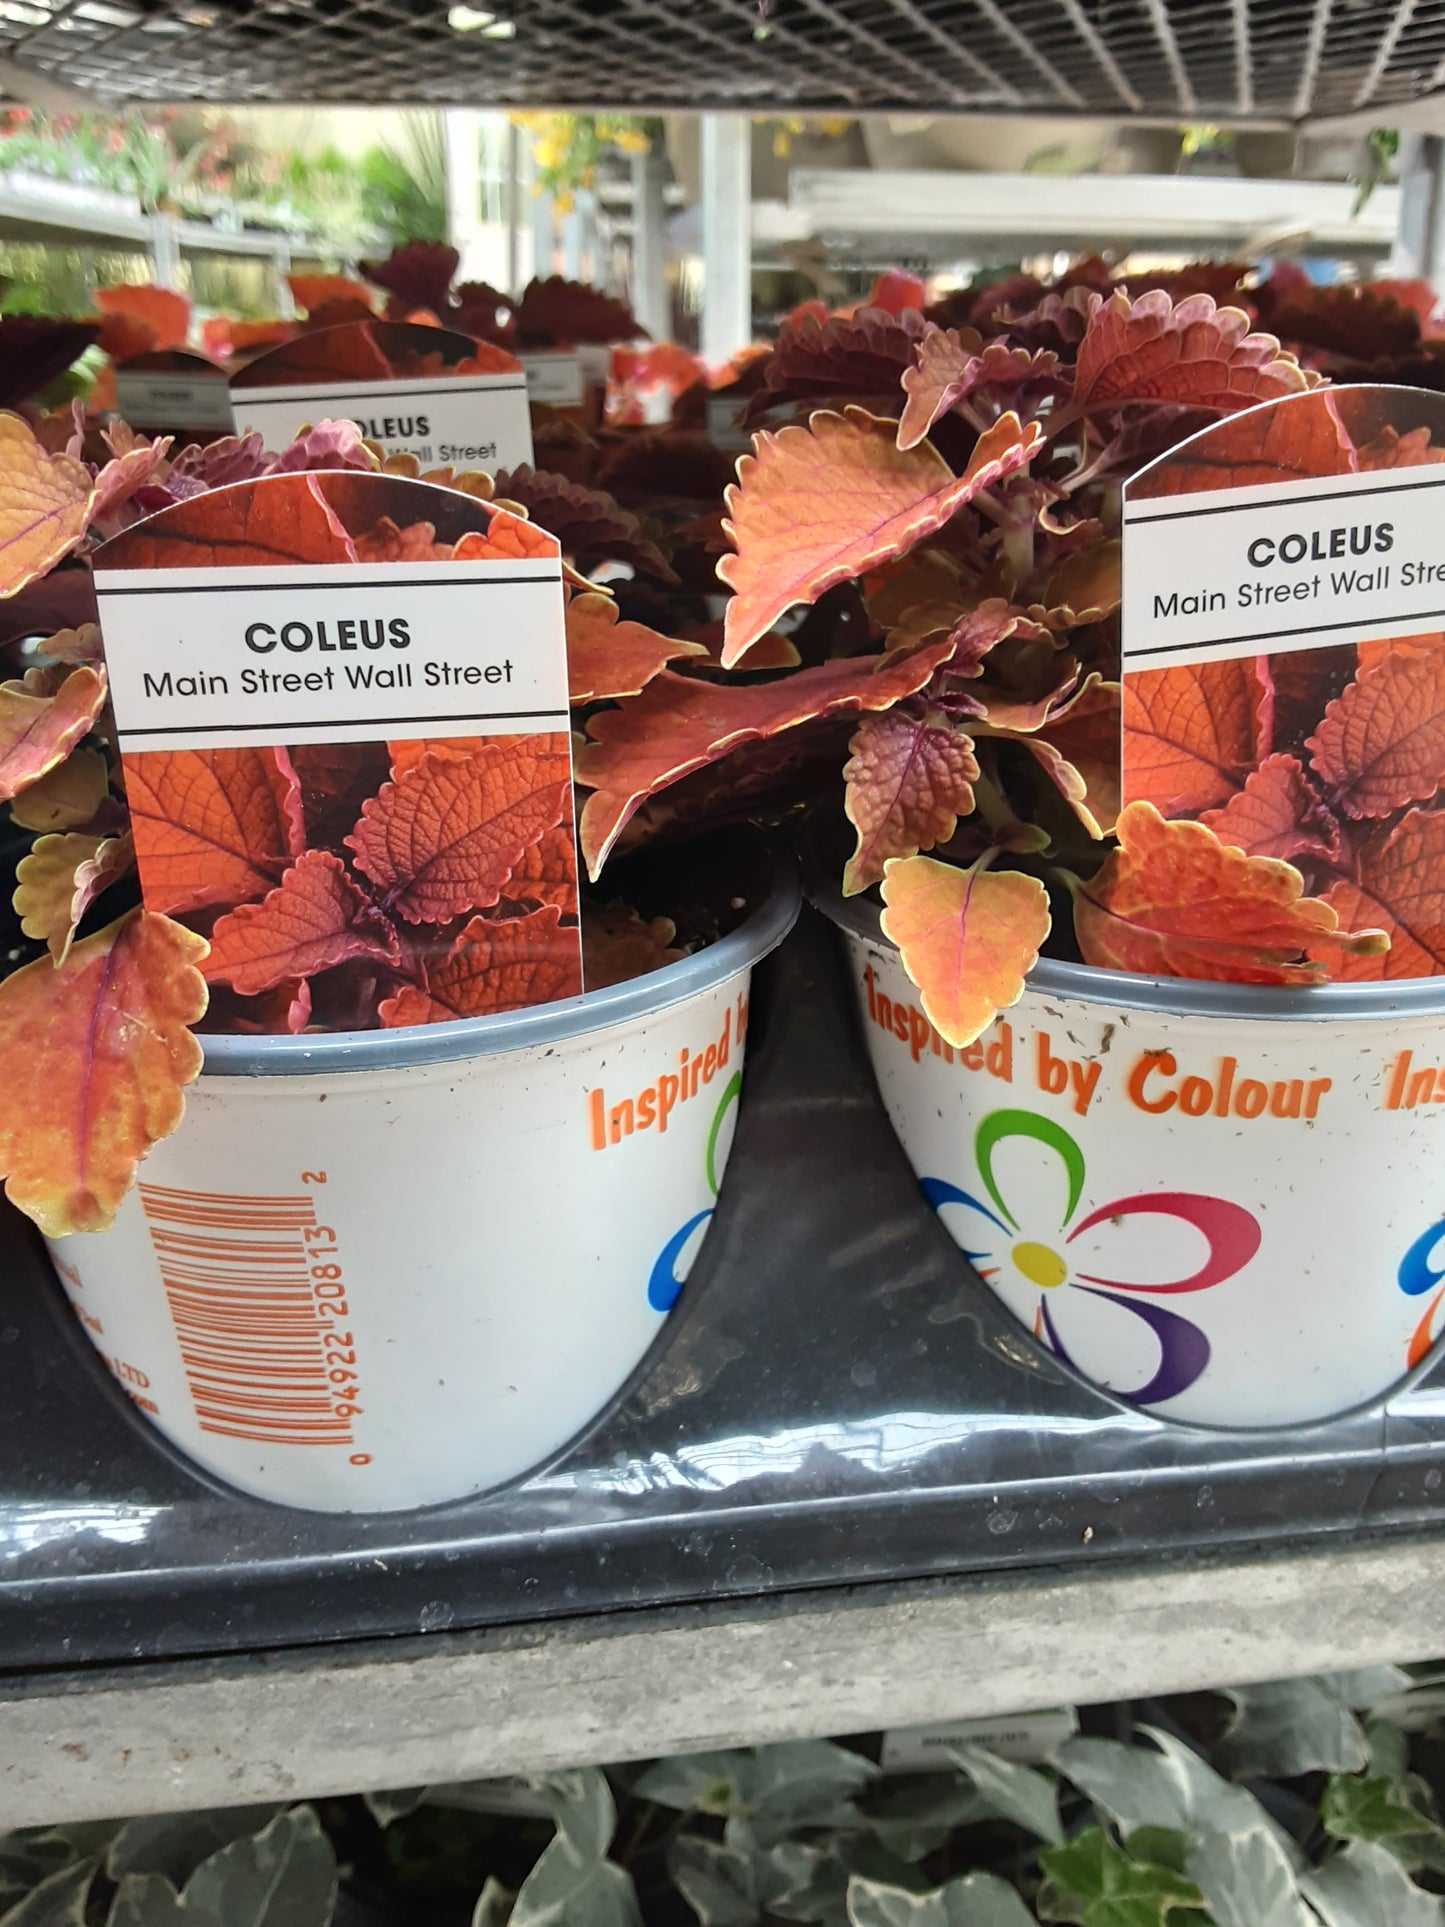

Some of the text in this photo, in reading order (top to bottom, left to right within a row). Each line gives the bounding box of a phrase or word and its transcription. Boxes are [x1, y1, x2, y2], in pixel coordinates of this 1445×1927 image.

[355, 416, 430, 439] LEUS
[439, 441, 497, 462] Street
[1247, 523, 1395, 568] COLEUS
[1153, 589, 1226, 618] Main
[1237, 575, 1321, 607] Street
[1330, 566, 1390, 595] Wall
[245, 618, 411, 653] COLEUS
[143, 659, 513, 697] Main Street Wall Street
[590, 991, 749, 1151] Inspired b
[1037, 1031, 1102, 1117] by
[1128, 1049, 1332, 1119] Colour
[301, 1170, 372, 1466] 0 94922 20813 2
